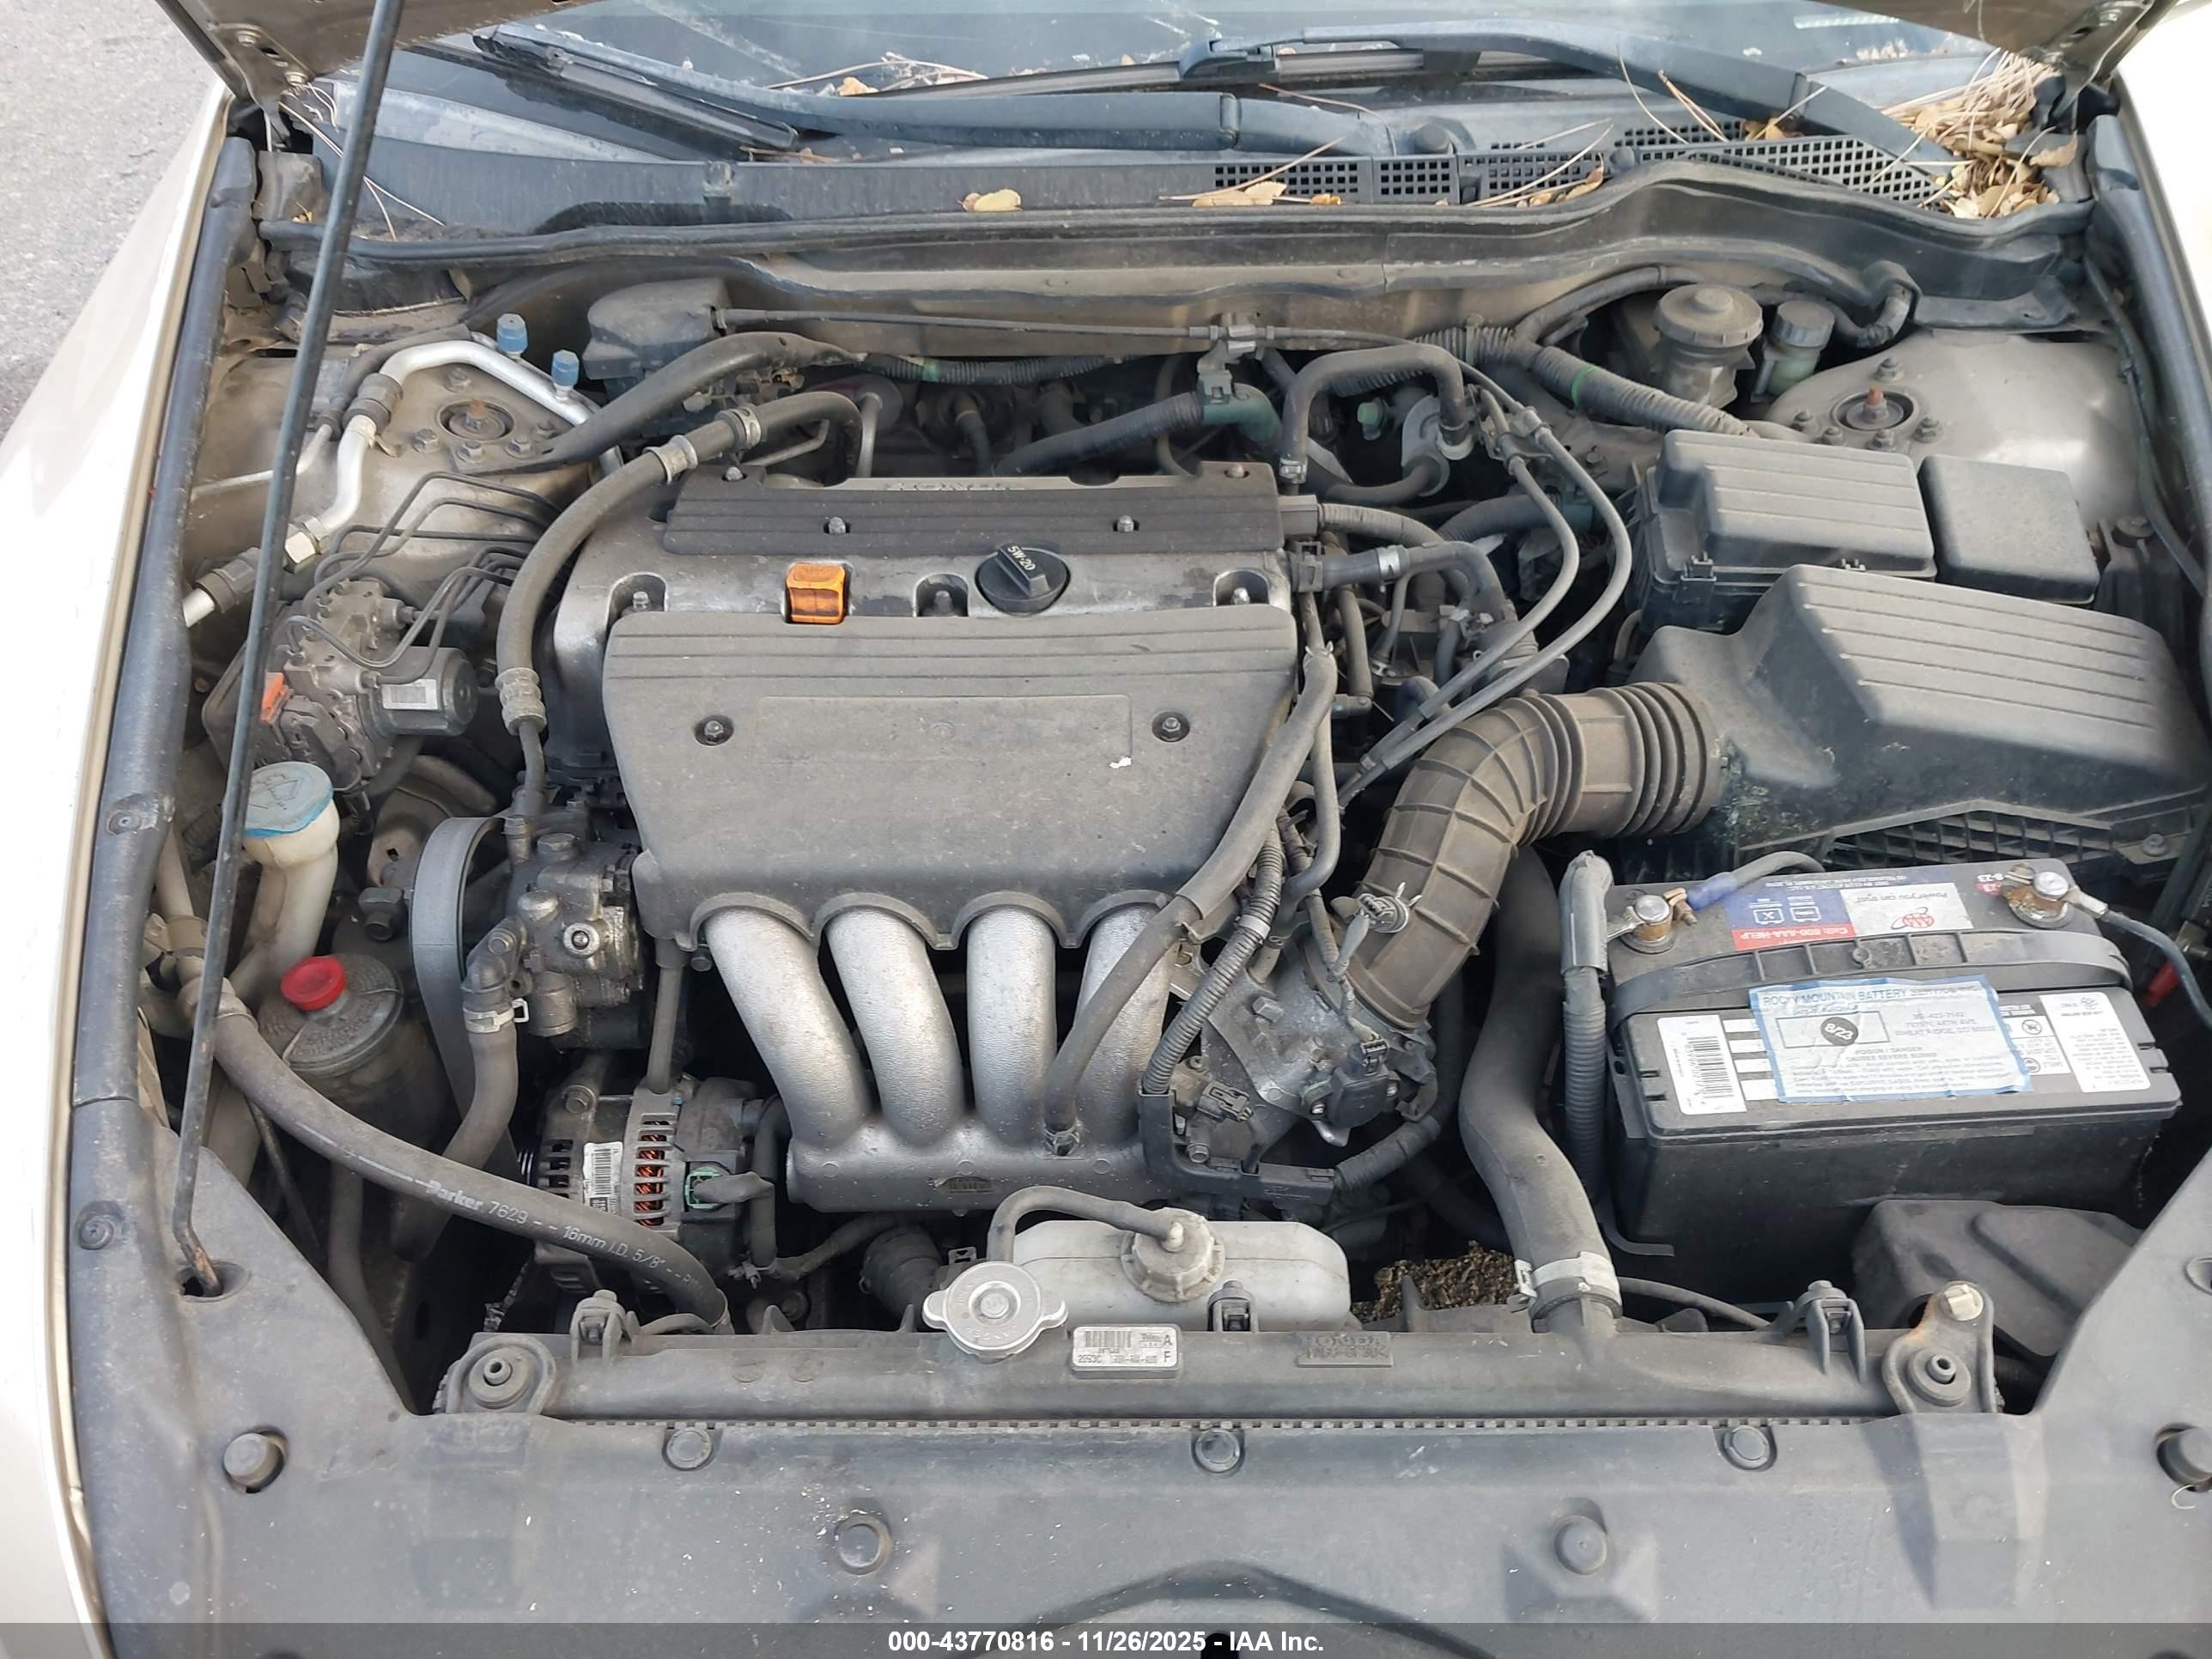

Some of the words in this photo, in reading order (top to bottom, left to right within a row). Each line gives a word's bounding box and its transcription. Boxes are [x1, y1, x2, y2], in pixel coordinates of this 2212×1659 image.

[1007, 544, 1036, 572] 5W-20
[1858, 988, 1906, 1001] BATTERY
[425, 1179, 483, 1210] Parker
[488, 1200, 528, 1224] 7629
[563, 1224, 608, 1249] 16mm
[1163, 1334, 1172, 1346] A
[1164, 1351, 1171, 1363] F
